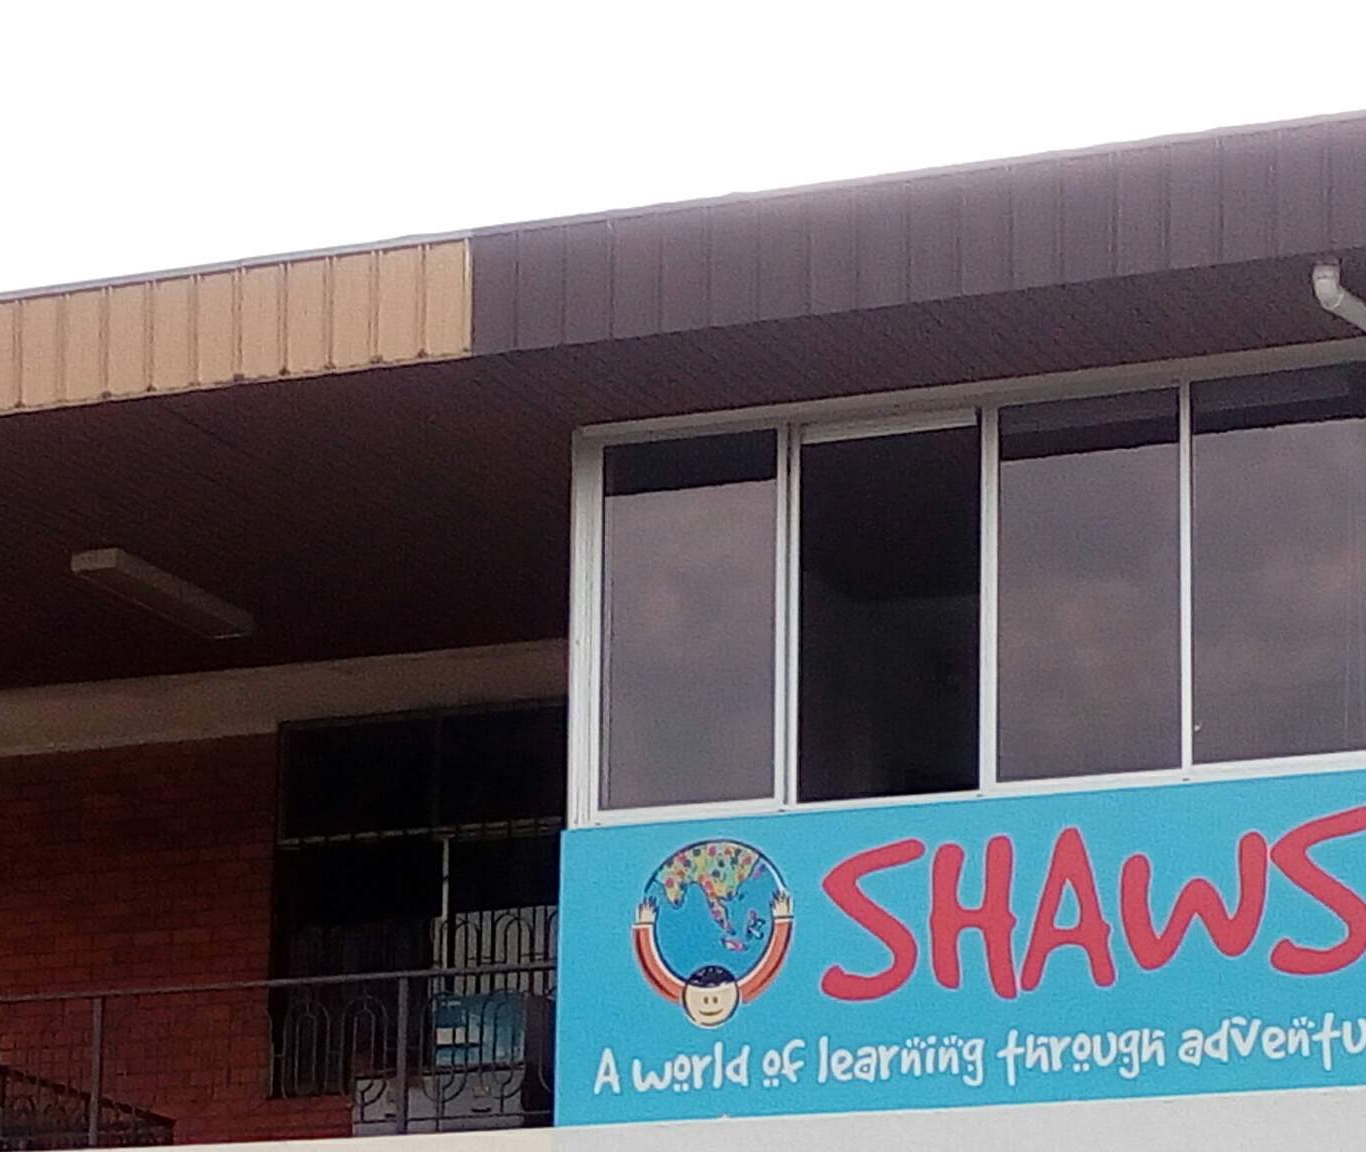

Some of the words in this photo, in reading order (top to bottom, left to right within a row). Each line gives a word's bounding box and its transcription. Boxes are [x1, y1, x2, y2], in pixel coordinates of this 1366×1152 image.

[593, 1047, 622, 1095] A
[633, 1041, 751, 1092] world
[763, 1038, 805, 1088] of
[817, 1034, 986, 1087] learning
[997, 1028, 1166, 1087] through
